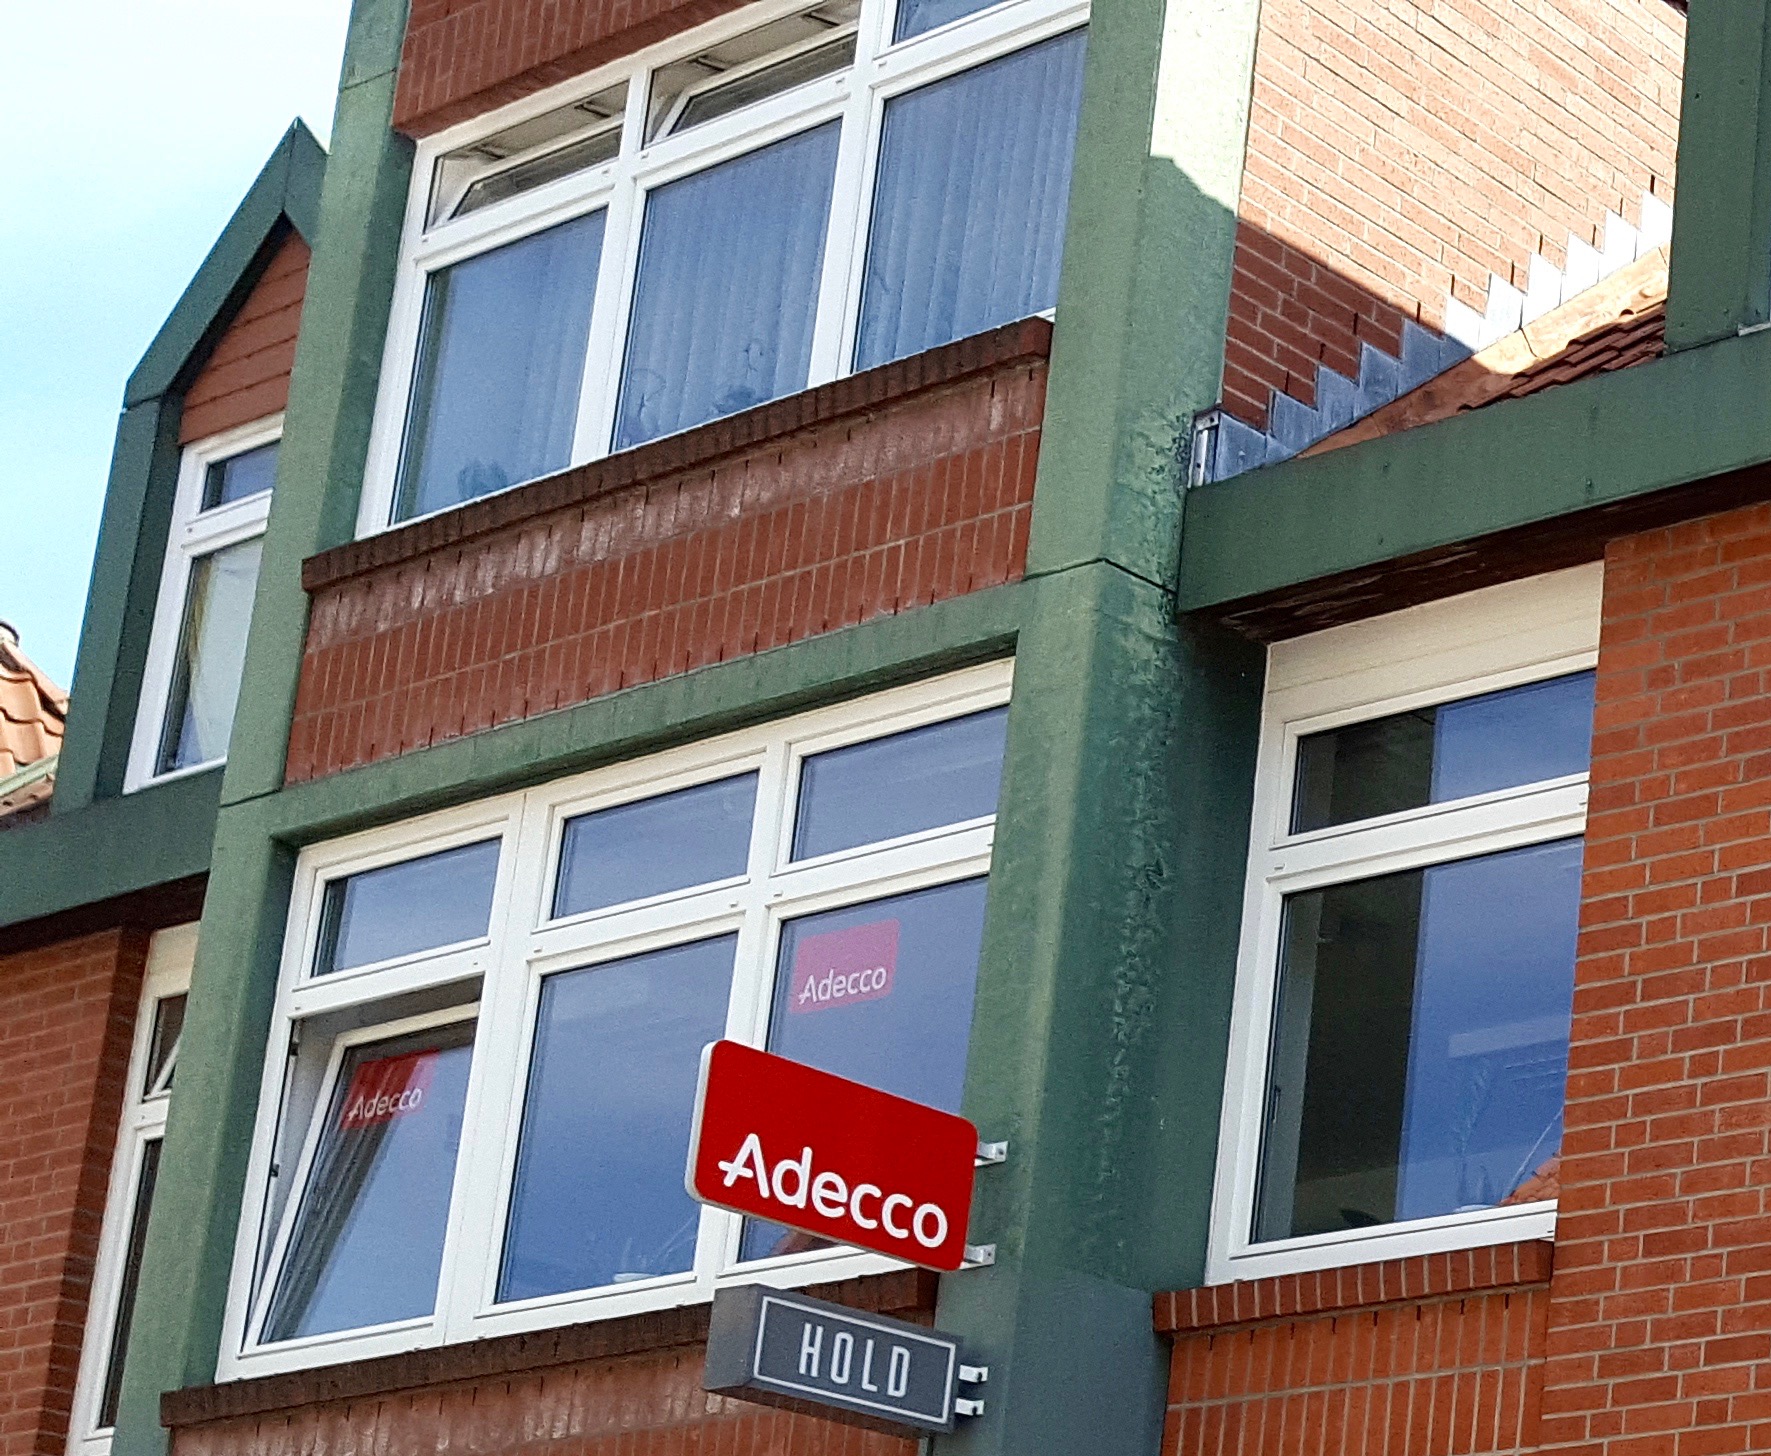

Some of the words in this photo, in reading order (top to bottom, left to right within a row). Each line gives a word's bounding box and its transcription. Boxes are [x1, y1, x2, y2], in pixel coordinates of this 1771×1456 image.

[799, 966, 888, 1006] Adecco
[348, 1088, 422, 1121] Adecco
[717, 1133, 949, 1249] Adecco
[799, 1322, 911, 1399] HOLD
